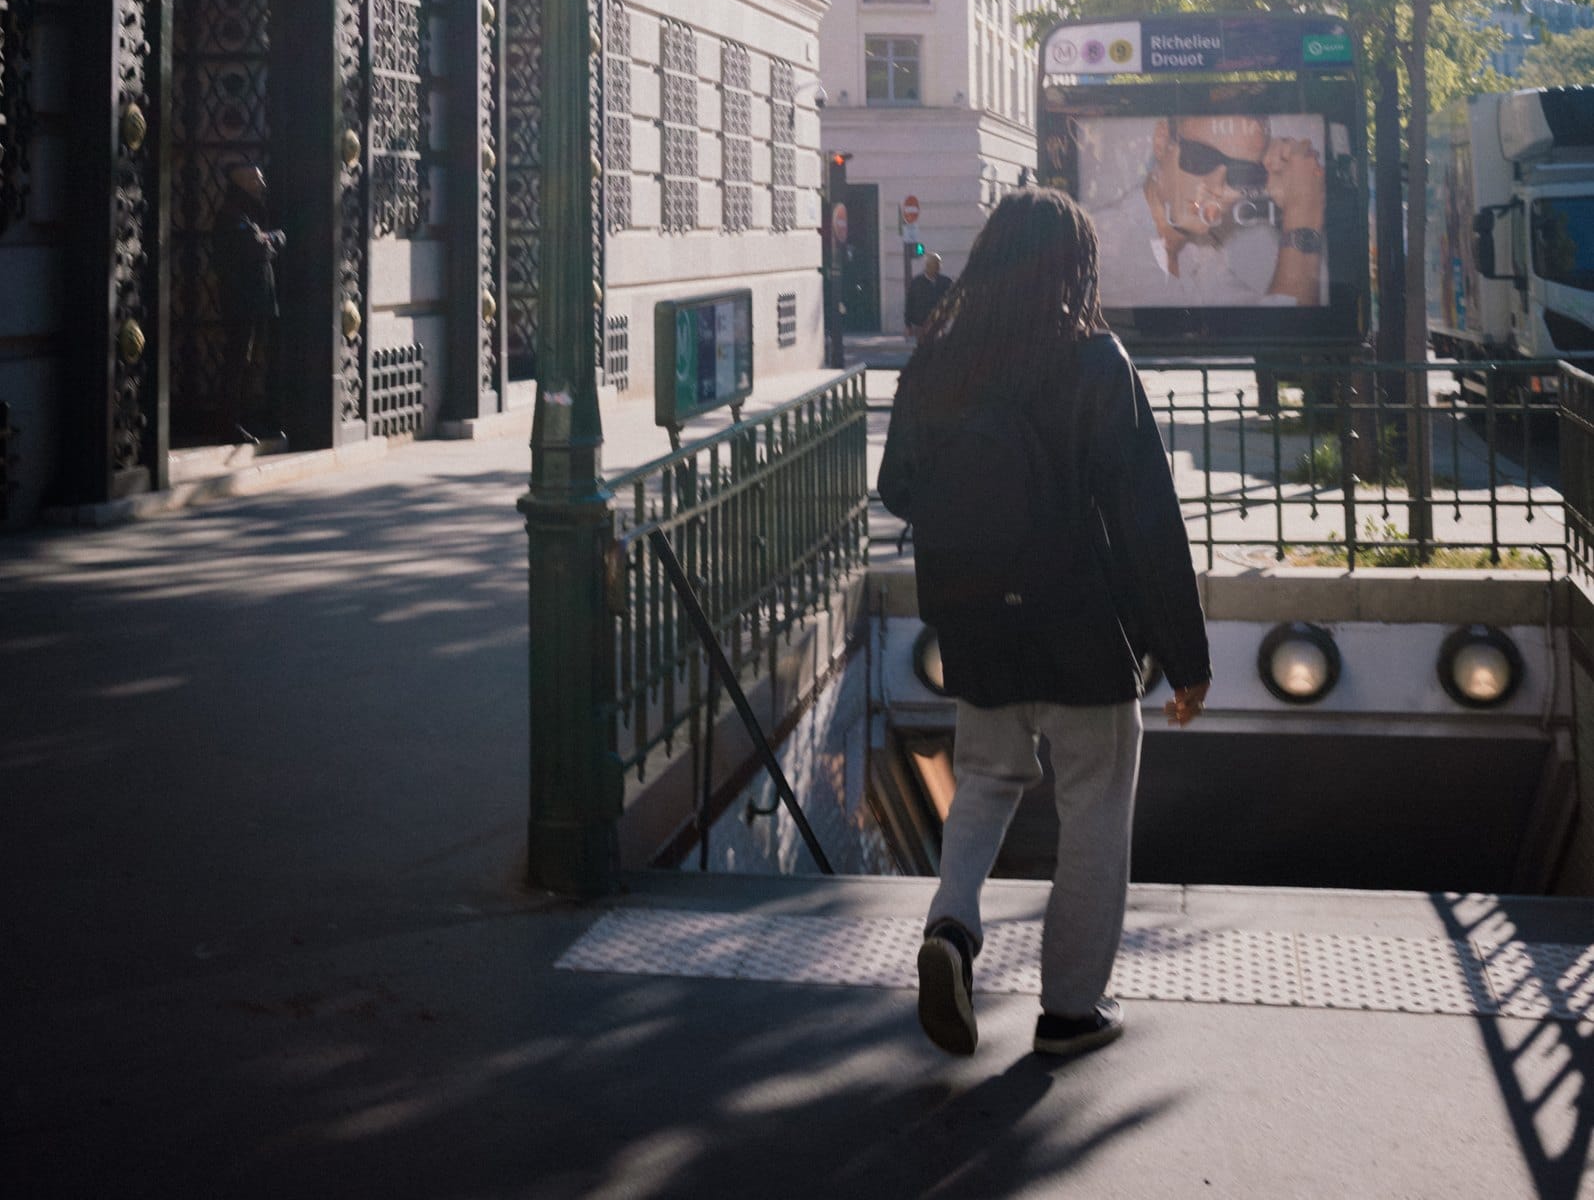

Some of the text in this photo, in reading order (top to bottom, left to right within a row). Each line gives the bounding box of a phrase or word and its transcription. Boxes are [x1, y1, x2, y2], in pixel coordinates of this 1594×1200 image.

[1151, 34, 1220, 49] Richelieu
[1115, 44, 1126, 59] 9
[1151, 52, 1204, 67] Drouot
